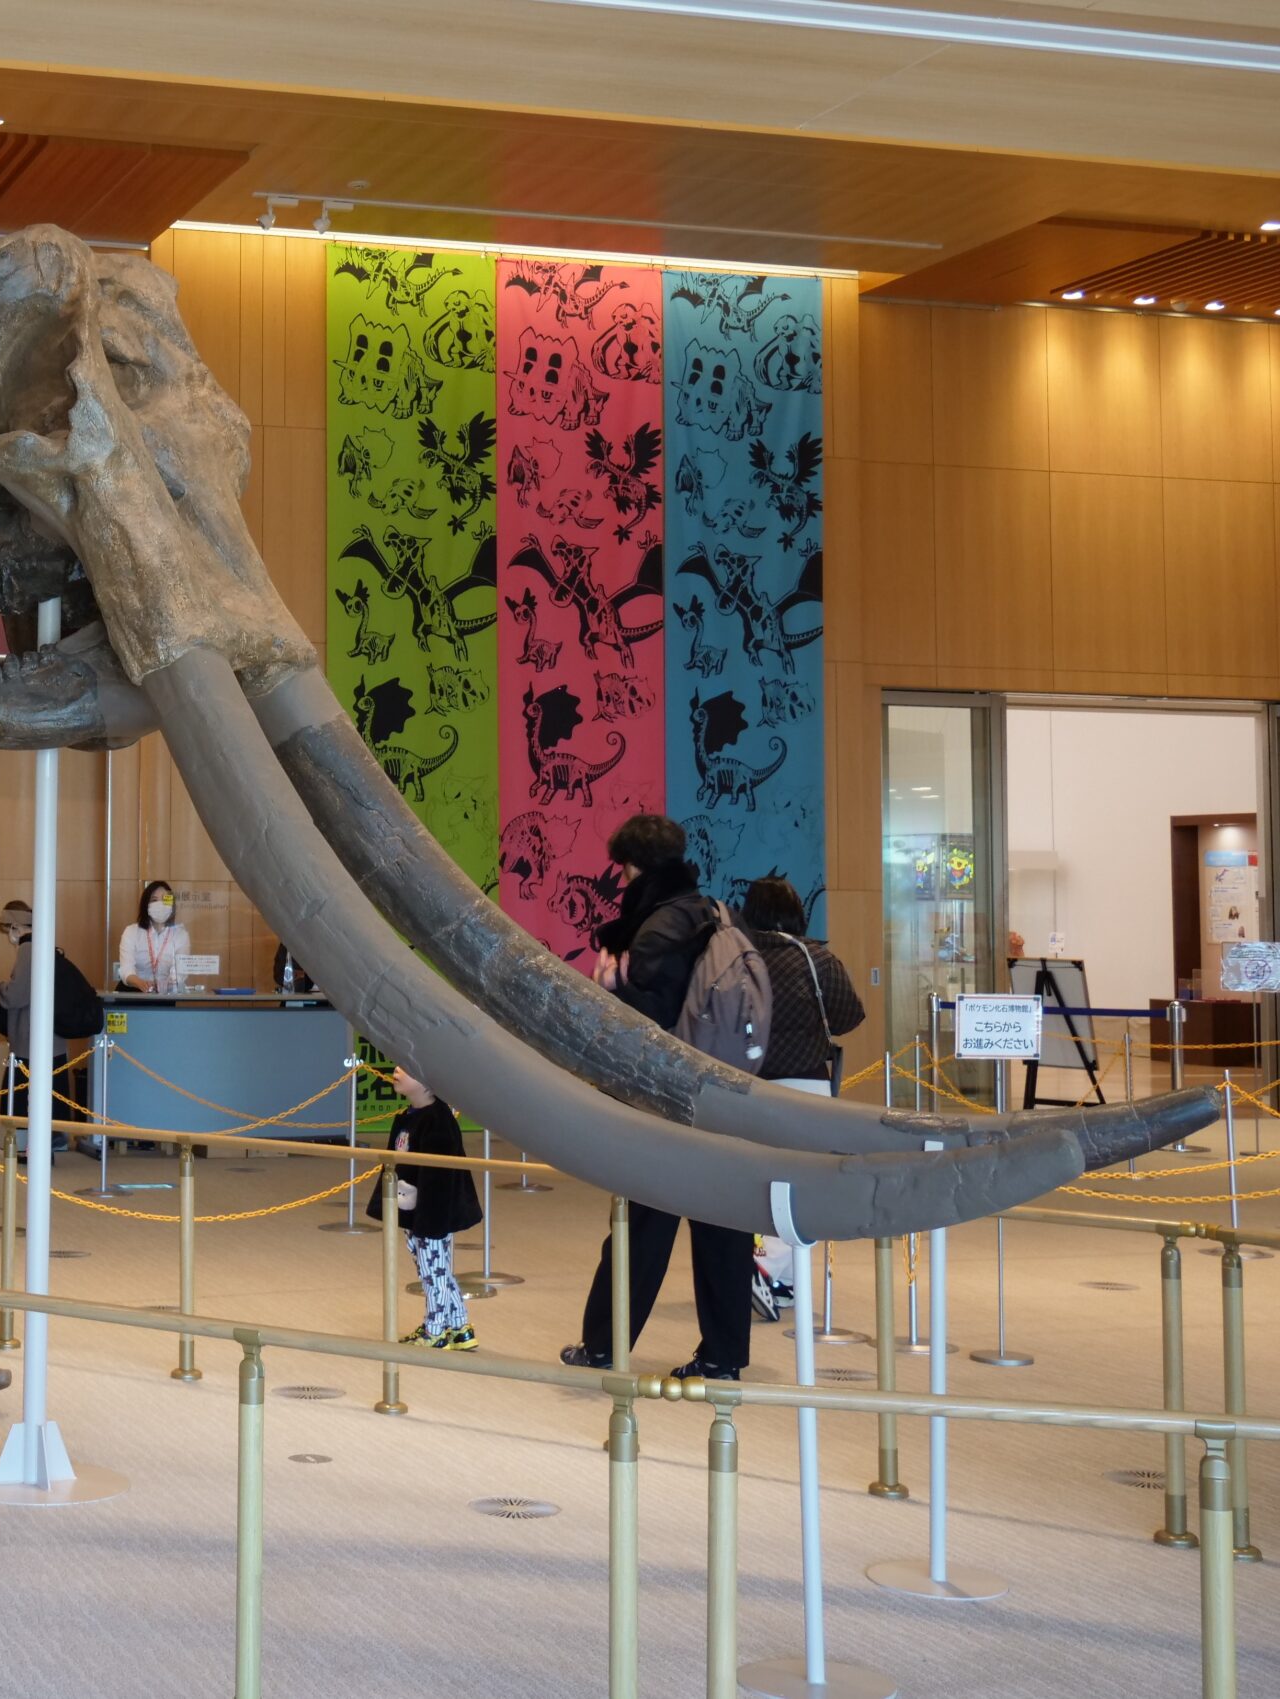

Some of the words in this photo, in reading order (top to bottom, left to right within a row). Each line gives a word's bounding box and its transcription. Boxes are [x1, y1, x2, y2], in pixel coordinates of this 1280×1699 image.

[965, 1003, 1032, 1013] 「ポケモン化石博物館」
[974, 1021, 1022, 1033] こちらから
[962, 1037, 1034, 1050] お進みください
